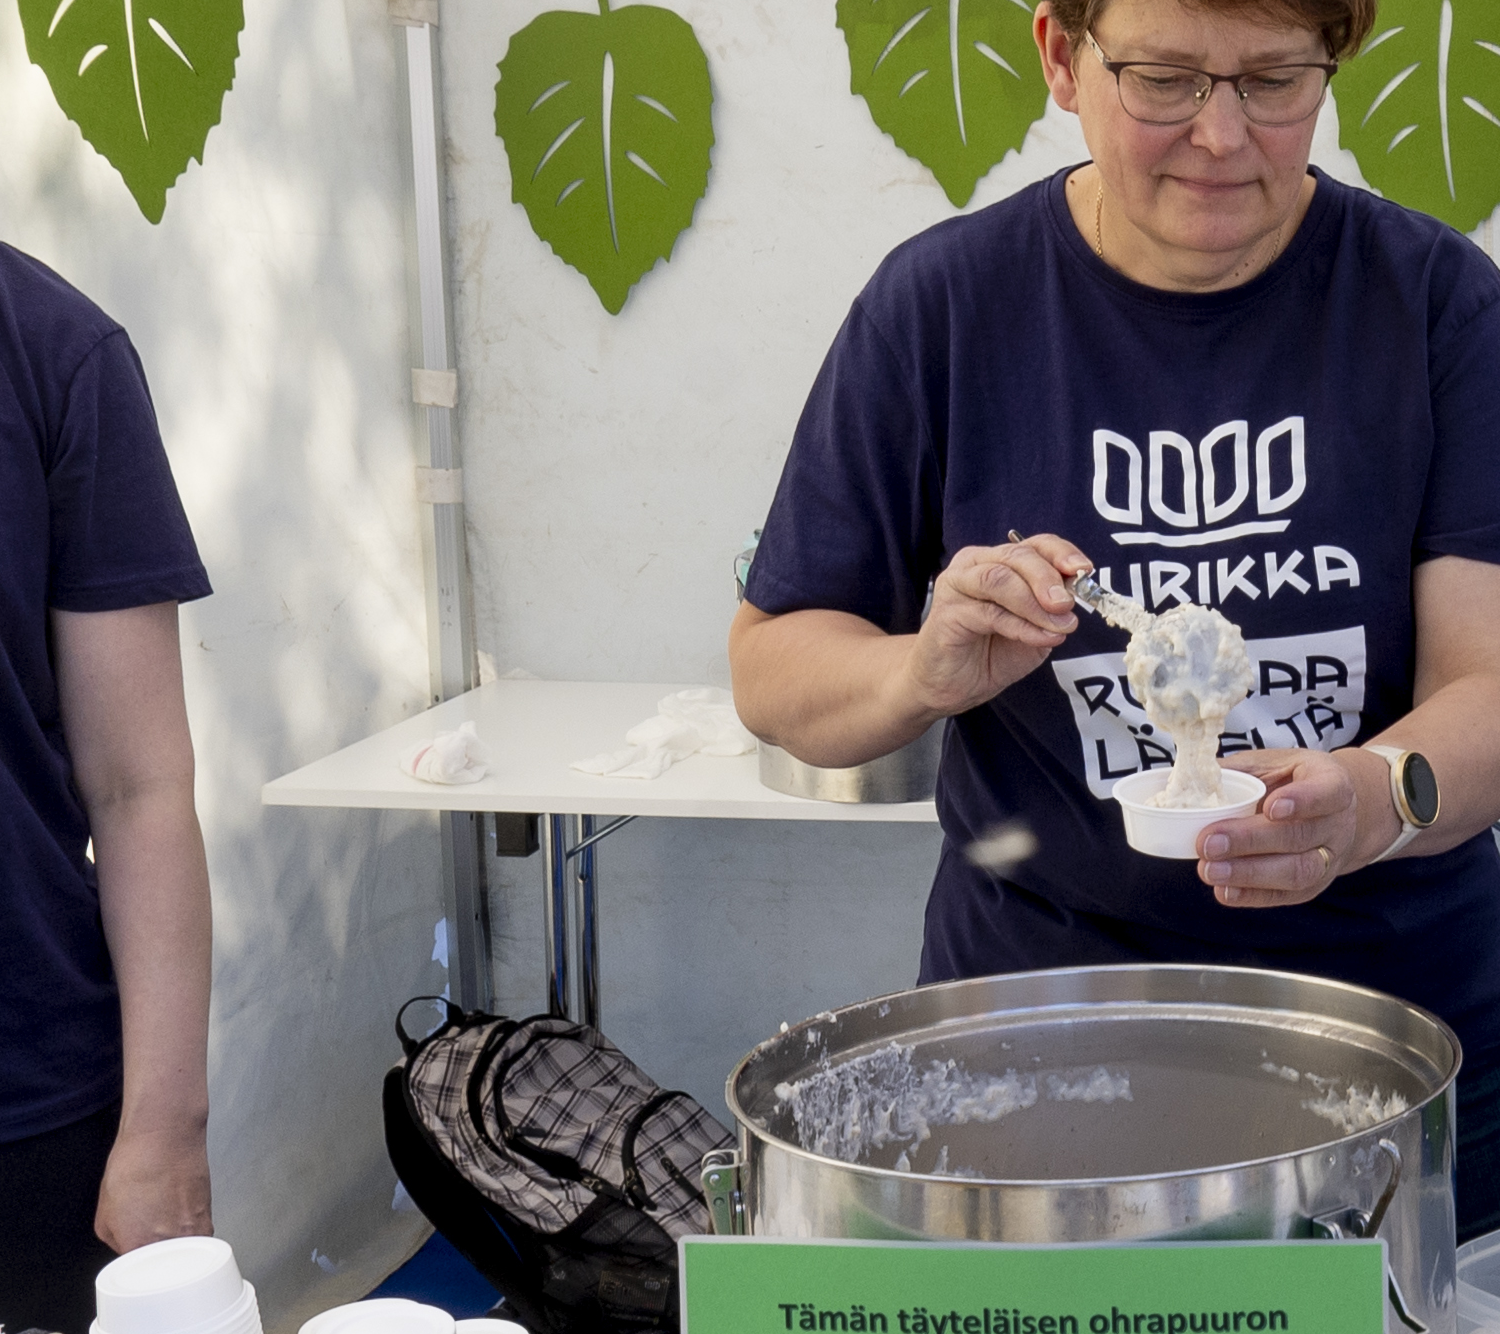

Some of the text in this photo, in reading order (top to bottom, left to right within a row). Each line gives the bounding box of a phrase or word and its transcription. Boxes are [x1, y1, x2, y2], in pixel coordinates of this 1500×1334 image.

[1076, 545, 1360, 614] URIKKA
[1074, 655, 1348, 716] RAA
[1096, 695, 1344, 780] LÄETÄ
[777, 1302, 889, 1334] Tämän
